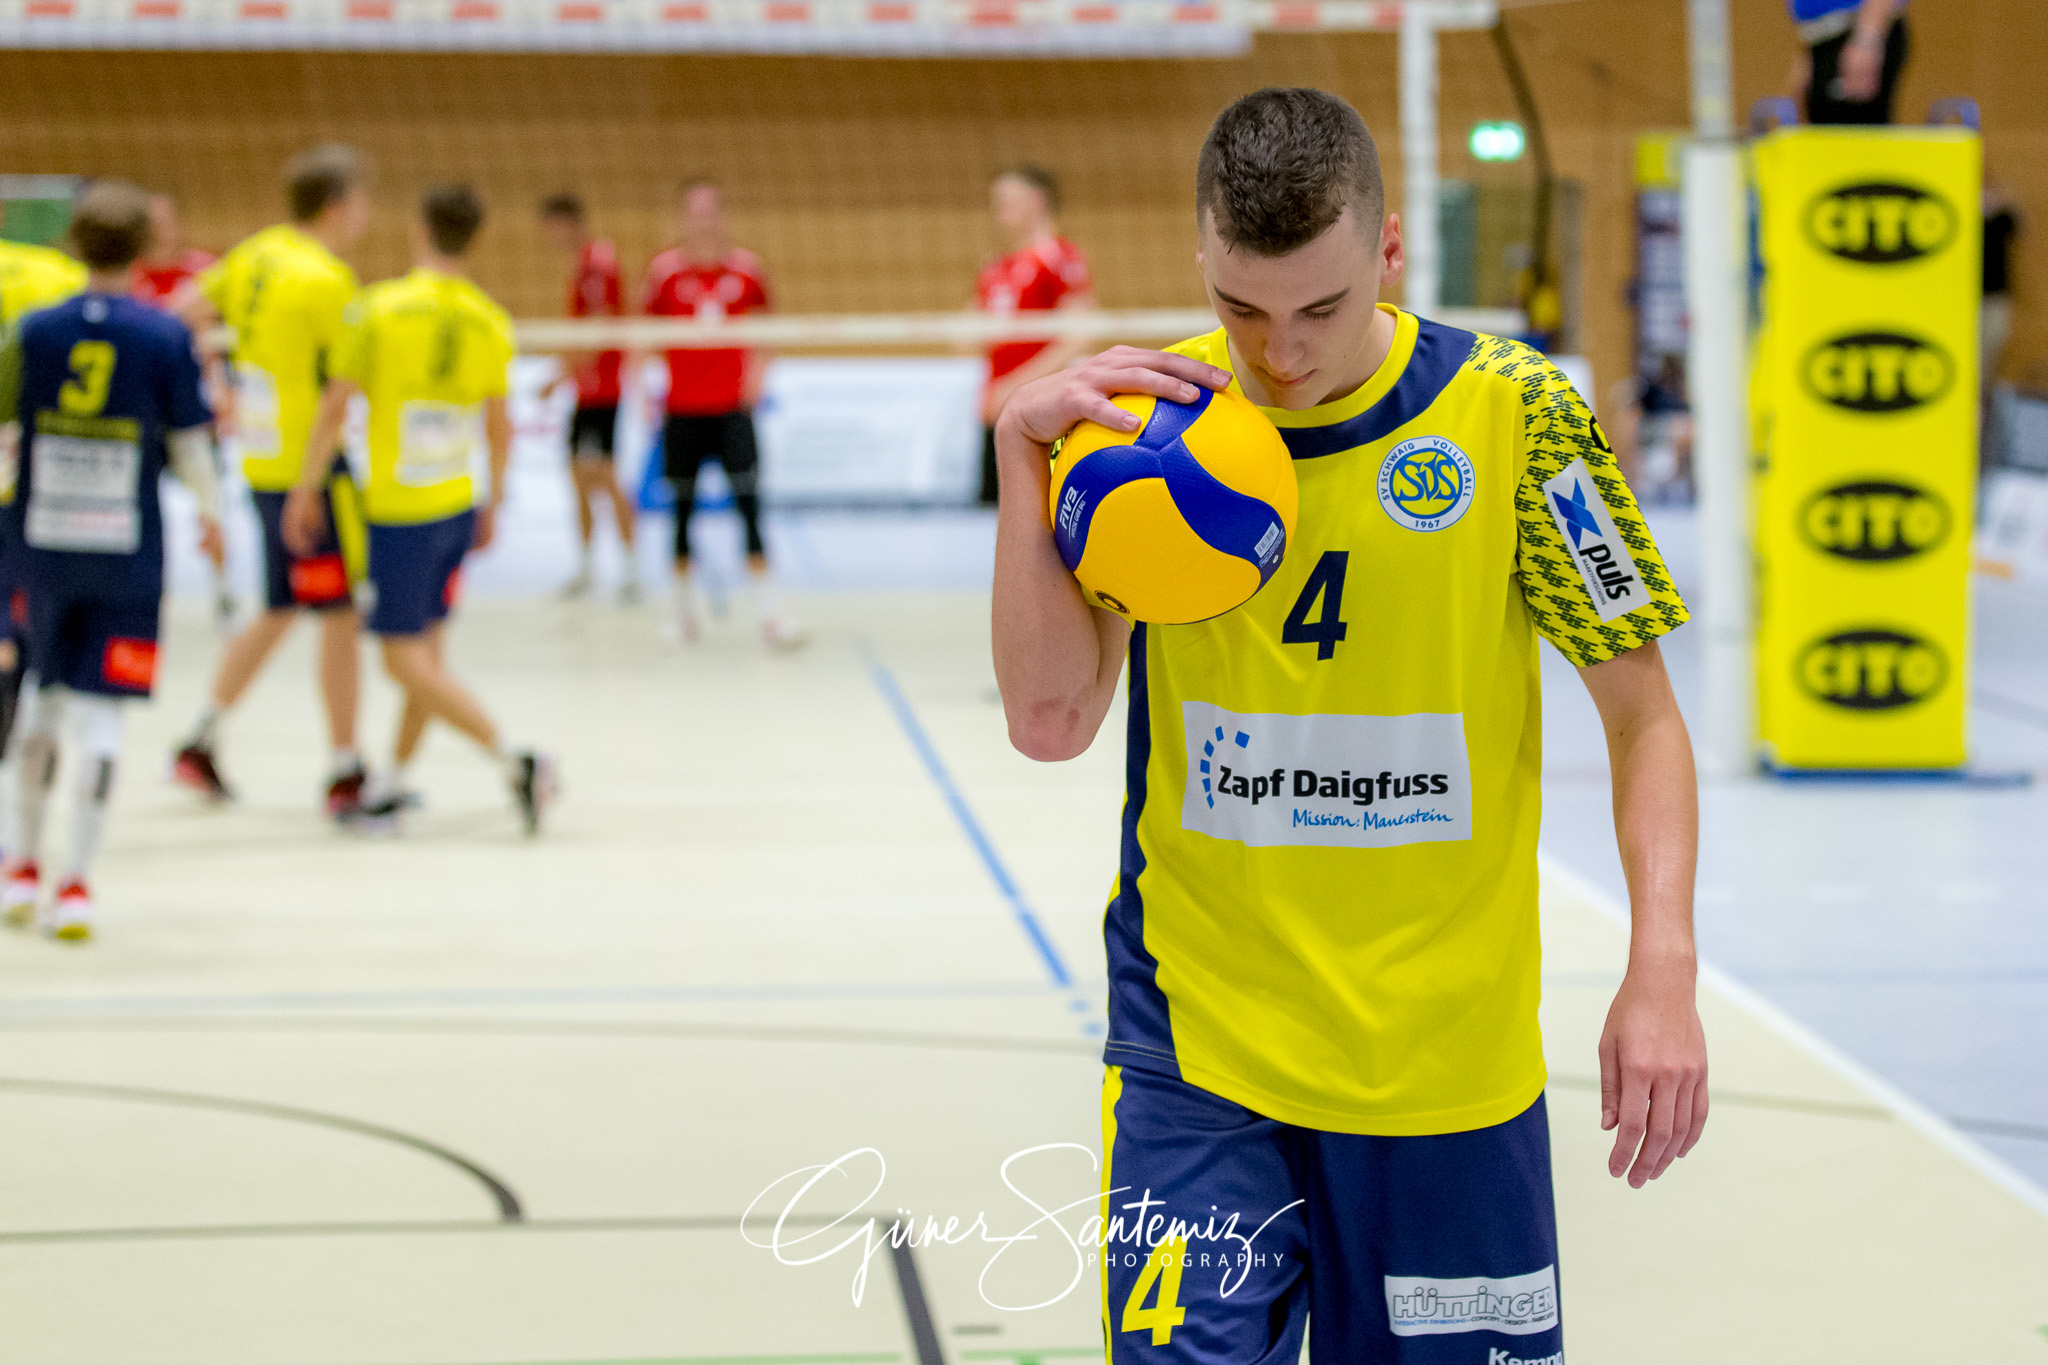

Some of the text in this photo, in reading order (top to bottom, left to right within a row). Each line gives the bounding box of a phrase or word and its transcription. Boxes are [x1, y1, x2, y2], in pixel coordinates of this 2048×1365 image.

[59, 340, 117, 416] 3
[1381, 439, 1472, 500] SV SCHWAIG VOLLEYBALL
[1060, 486, 1078, 530] FIVB
[1415, 520, 1440, 529] 1967
[1578, 543, 1634, 600] puls
[1281, 551, 1349, 661] 4
[1218, 765, 1449, 806] Zapf Daigfuss
[1293, 808, 1360, 828] Mission:
[1121, 1235, 1186, 1346] 4
[1393, 1285, 1555, 1318] HÜTTINGER
